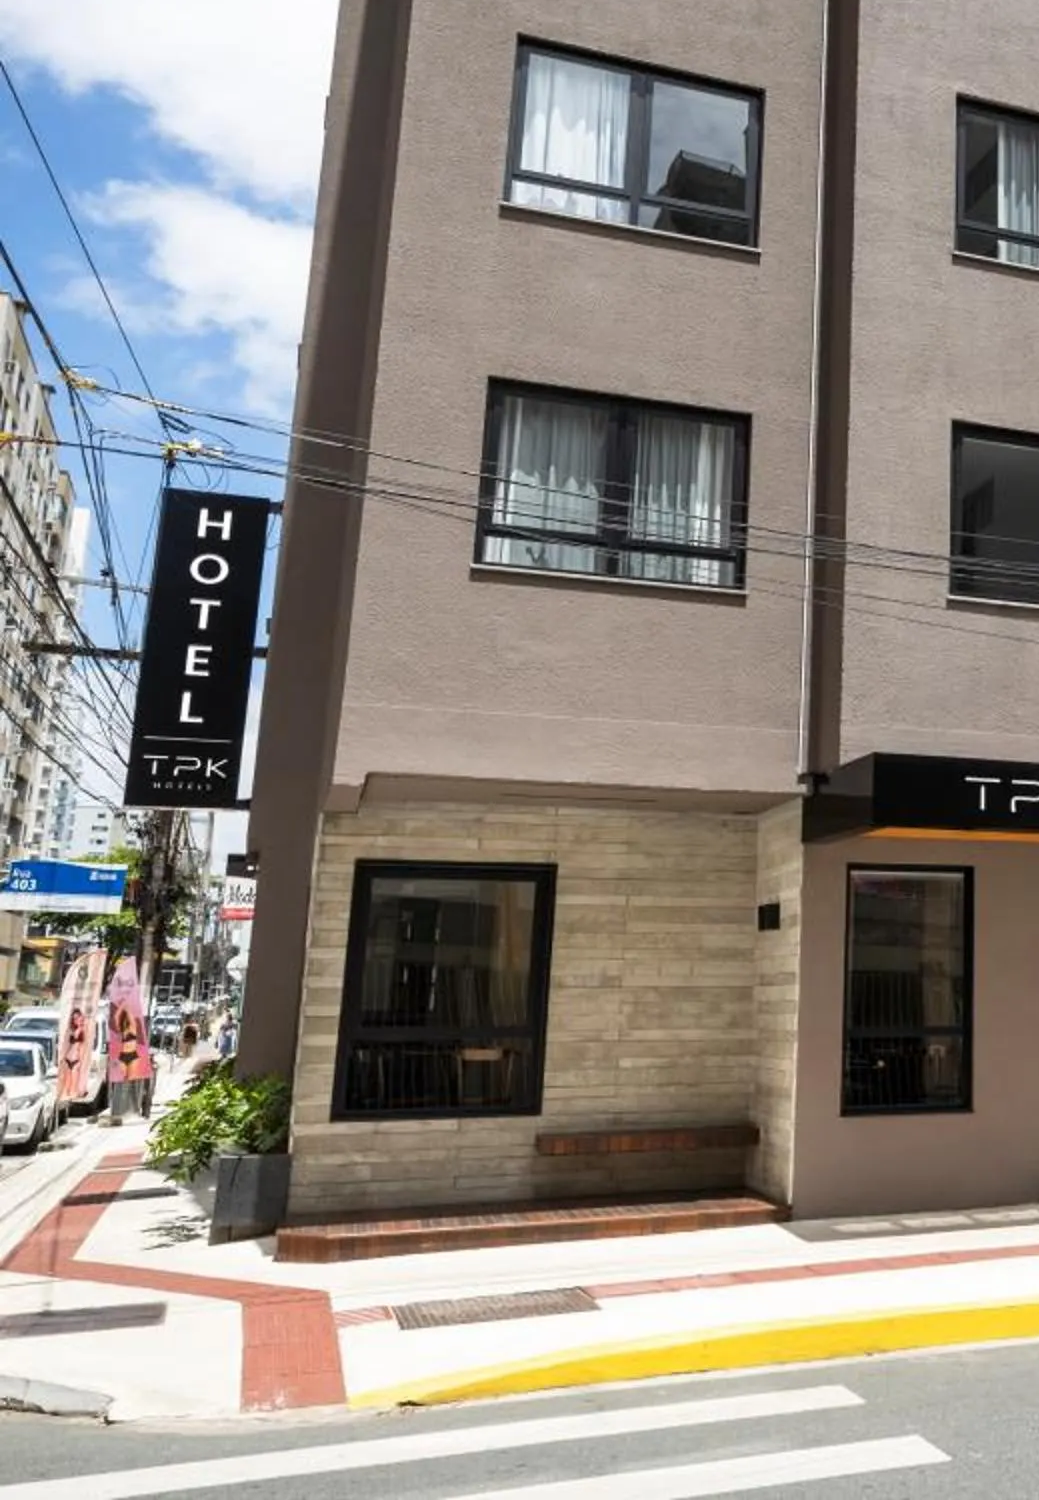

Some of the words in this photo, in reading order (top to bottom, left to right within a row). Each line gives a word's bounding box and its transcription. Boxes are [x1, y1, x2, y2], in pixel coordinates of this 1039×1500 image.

[179, 507, 233, 724] HOTEL
[143, 754, 228, 779] TPK
[10, 878, 37, 891] 403
